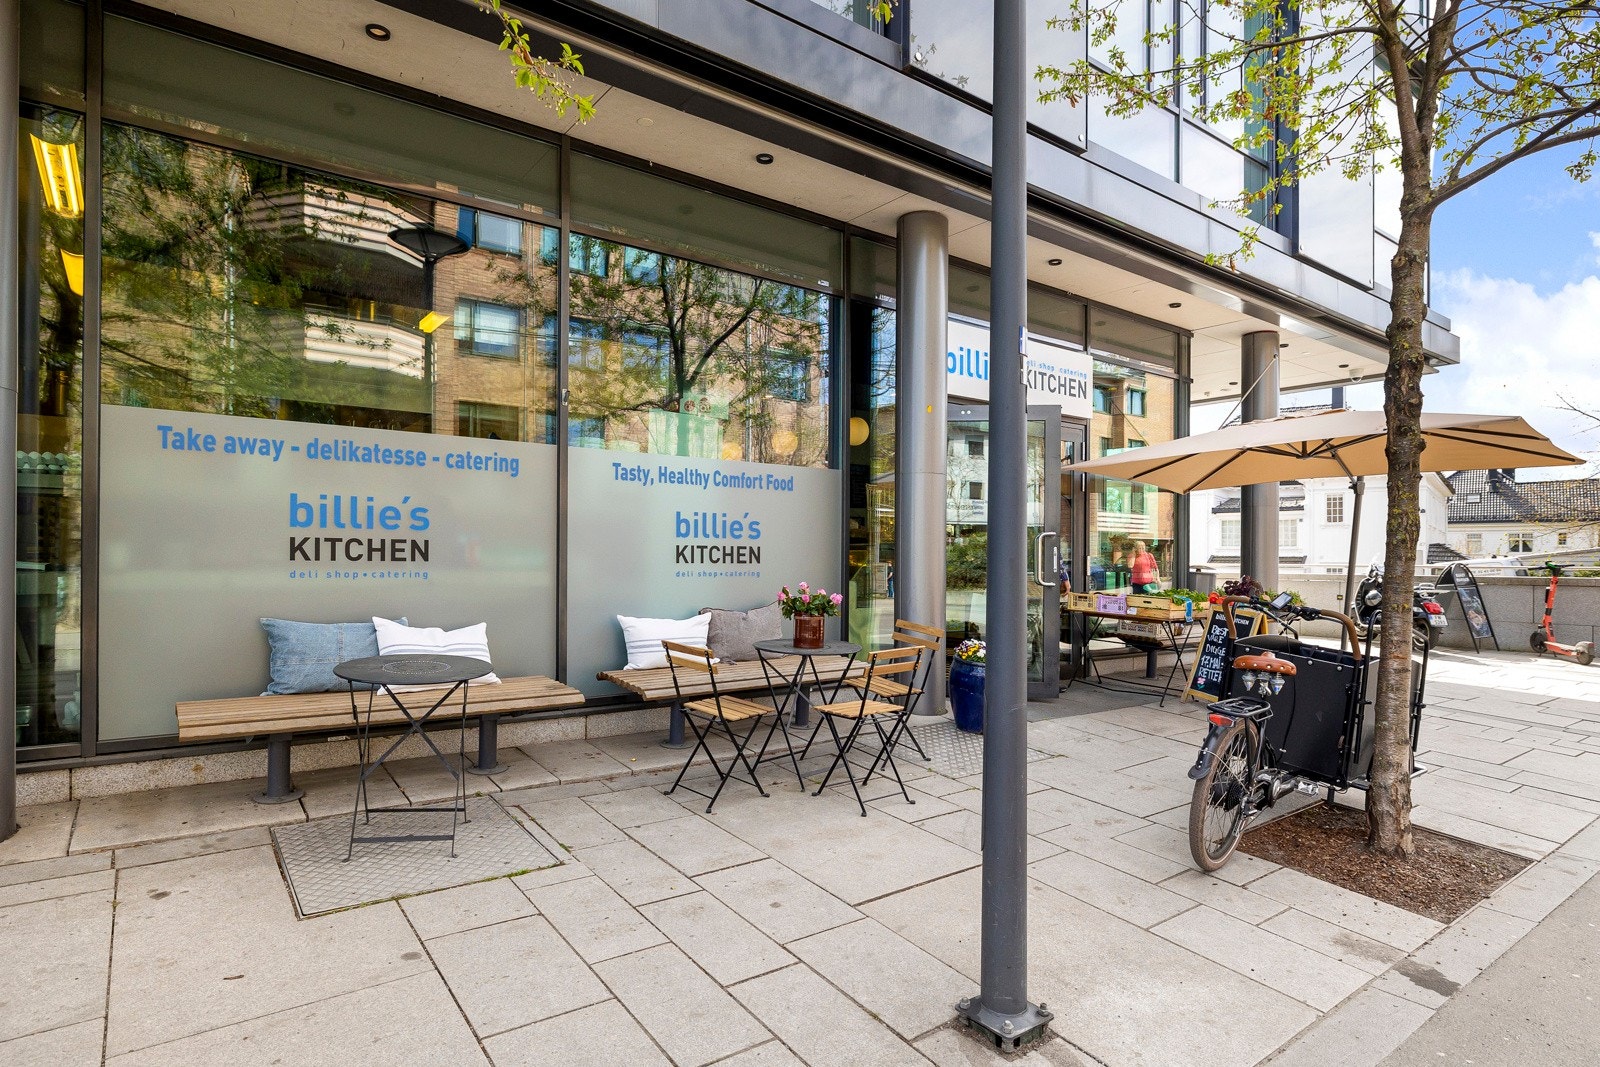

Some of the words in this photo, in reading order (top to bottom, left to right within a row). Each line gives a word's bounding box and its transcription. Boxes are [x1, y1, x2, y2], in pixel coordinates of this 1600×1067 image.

[947, 347, 988, 380] billi
[157, 425, 216, 453] Take
[224, 436, 284, 462] away
[307, 438, 426, 467] delikatesse
[446, 452, 519, 477] catering
[611, 462, 655, 486] Tasty,
[657, 465, 710, 491] Healthy
[712, 469, 763, 490] Comfort
[766, 474, 794, 493] Food
[290, 537, 429, 562] KITCHEN
[676, 545, 760, 564] KITCHEN
[289, 570, 318, 579] deli
